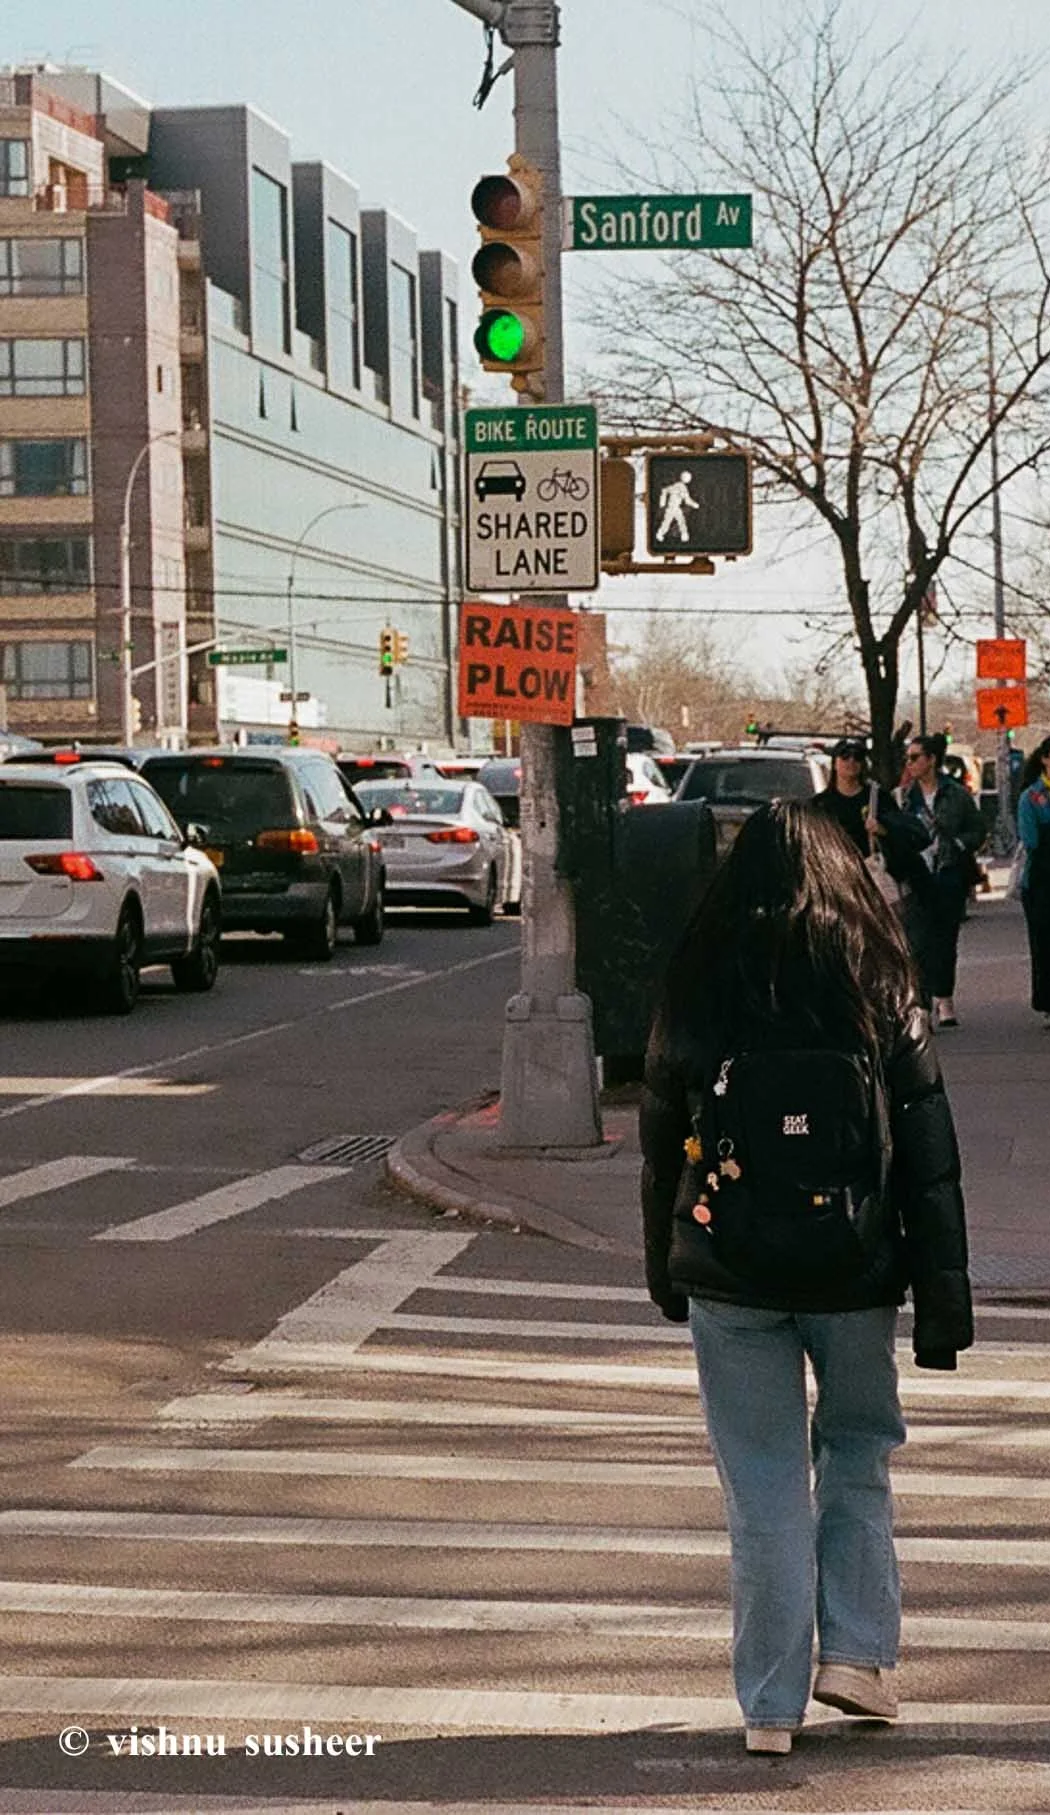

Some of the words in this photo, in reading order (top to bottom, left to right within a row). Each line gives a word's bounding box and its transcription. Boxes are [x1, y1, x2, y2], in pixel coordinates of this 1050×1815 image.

[579, 202, 701, 243] Sanford
[716, 202, 740, 226] Av
[474, 420, 516, 442] BIKE
[525, 416, 587, 440] ROUTE
[477, 511, 587, 540] SHARED
[495, 548, 568, 576] LANE
[465, 615, 575, 654] RAISE
[467, 663, 570, 700] PLOW
